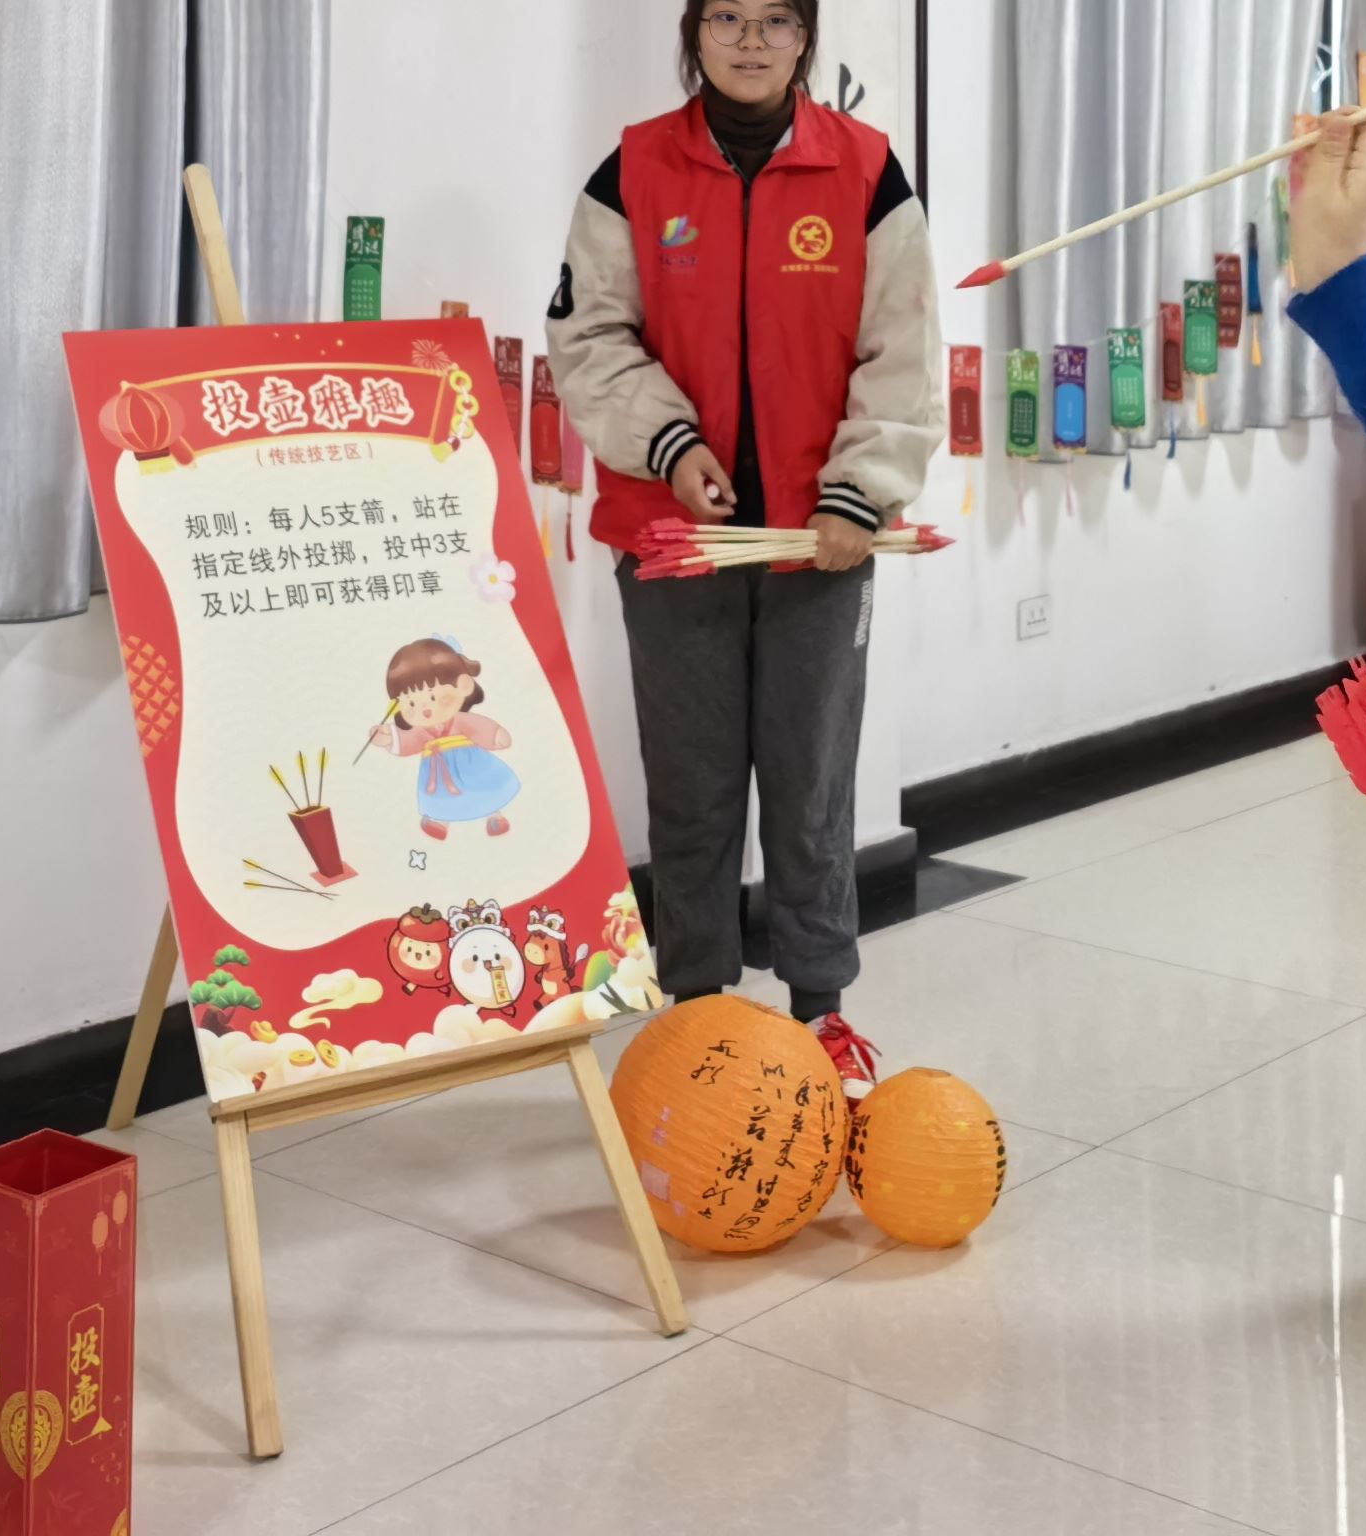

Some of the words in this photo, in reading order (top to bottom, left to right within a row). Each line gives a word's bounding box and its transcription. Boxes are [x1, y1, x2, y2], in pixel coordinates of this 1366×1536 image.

[201, 374, 415, 437] 投壶雅趣
[185, 493, 463, 540] 规则：每人5支箭，站在
[192, 529, 471, 580] 指定线外投掷，投中3支
[201, 570, 443, 618] 及以上即可获得印章
[69, 1326, 102, 1424] 投壶
